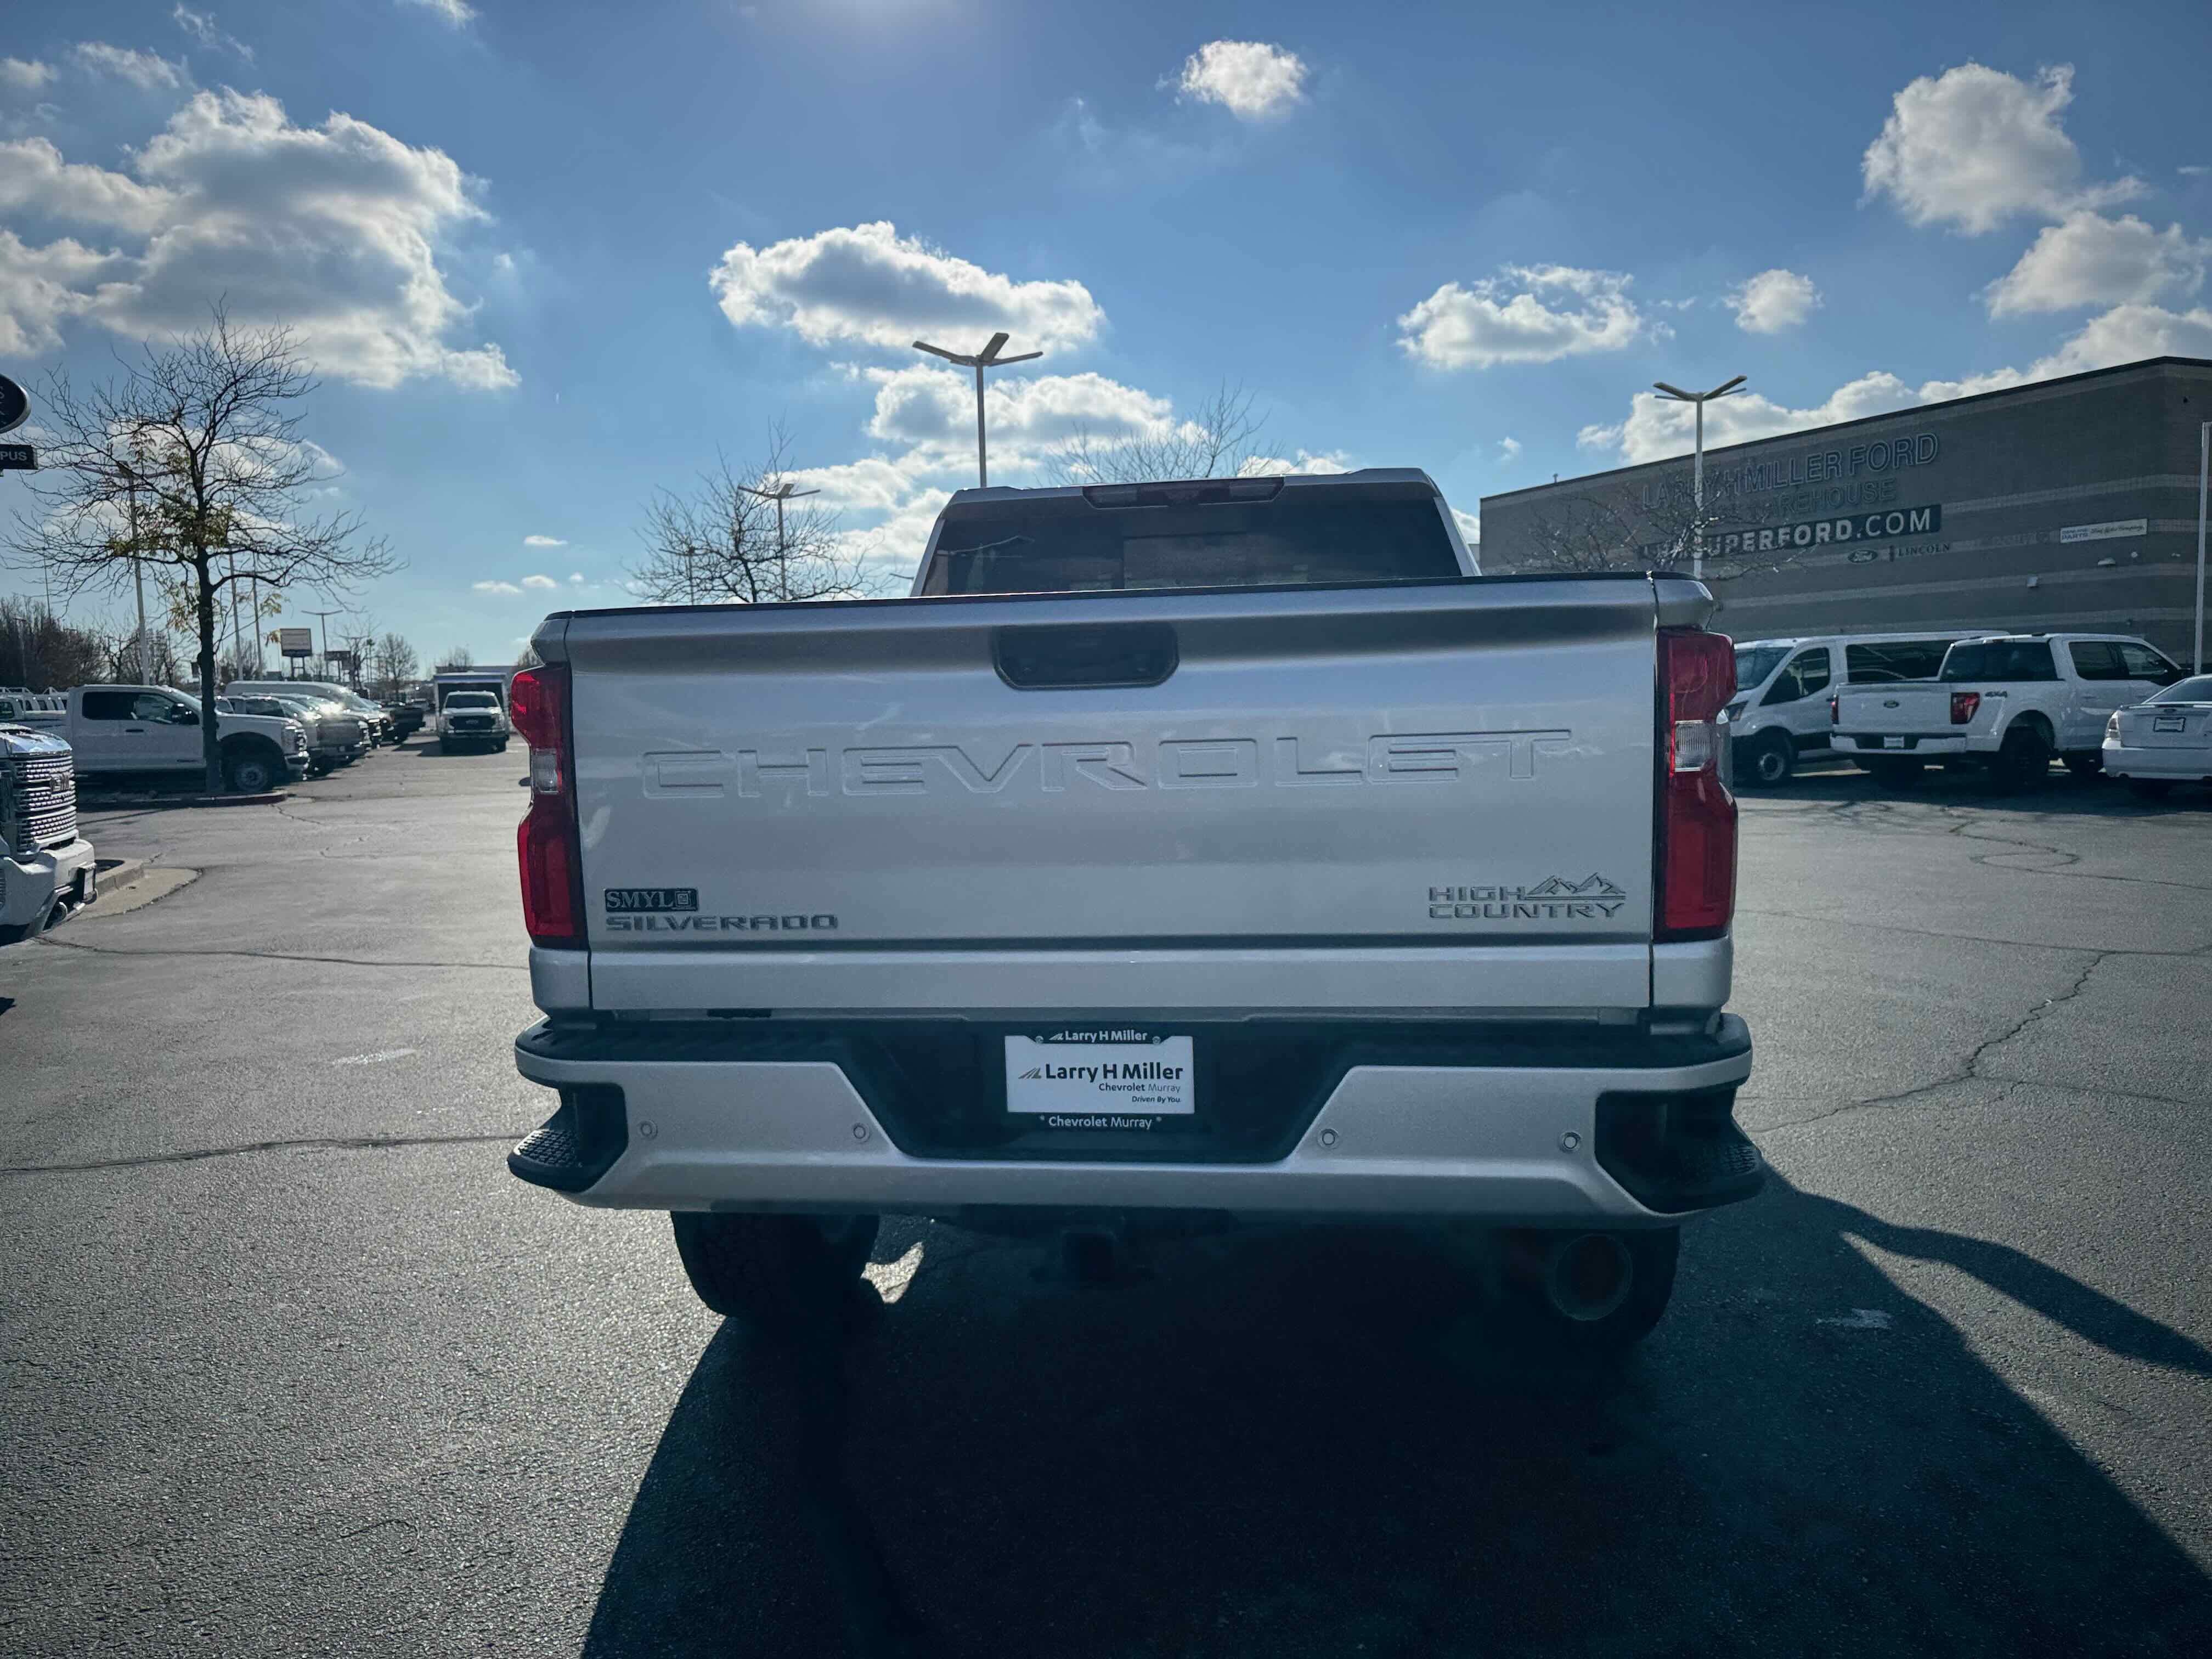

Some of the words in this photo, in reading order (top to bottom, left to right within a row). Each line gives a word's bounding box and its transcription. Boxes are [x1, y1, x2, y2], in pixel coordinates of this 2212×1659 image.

[1743, 450, 1842, 492] MILLER
[1848, 432, 1939, 476] FORD
[1750, 477, 1897, 518] AREHOUSE
[1639, 507, 1931, 558] UPERFORD.COM
[1898, 544, 1950, 556] LINCOLN
[643, 729, 1572, 798] CHEVROLET
[606, 891, 674, 909] SMYL
[1429, 886, 1526, 901] HIGH
[1429, 902, 1624, 918] COUNTRY
[606, 914, 838, 932] SILVERADO
[1065, 1031, 1097, 1043] Larry
[1099, 1031, 1109, 1040] H
[1111, 1029, 1147, 1041] Miller
[1046, 1064, 1097, 1082] Larry
[1103, 1064, 1117, 1079] H
[1122, 1063, 1183, 1080] Miller
[1098, 1082, 1146, 1091] Chevrolet
[1148, 1084, 1181, 1093] Murray
[1048, 1116, 1107, 1127] Chevrolet
[1110, 1116, 1152, 1130] Murray
